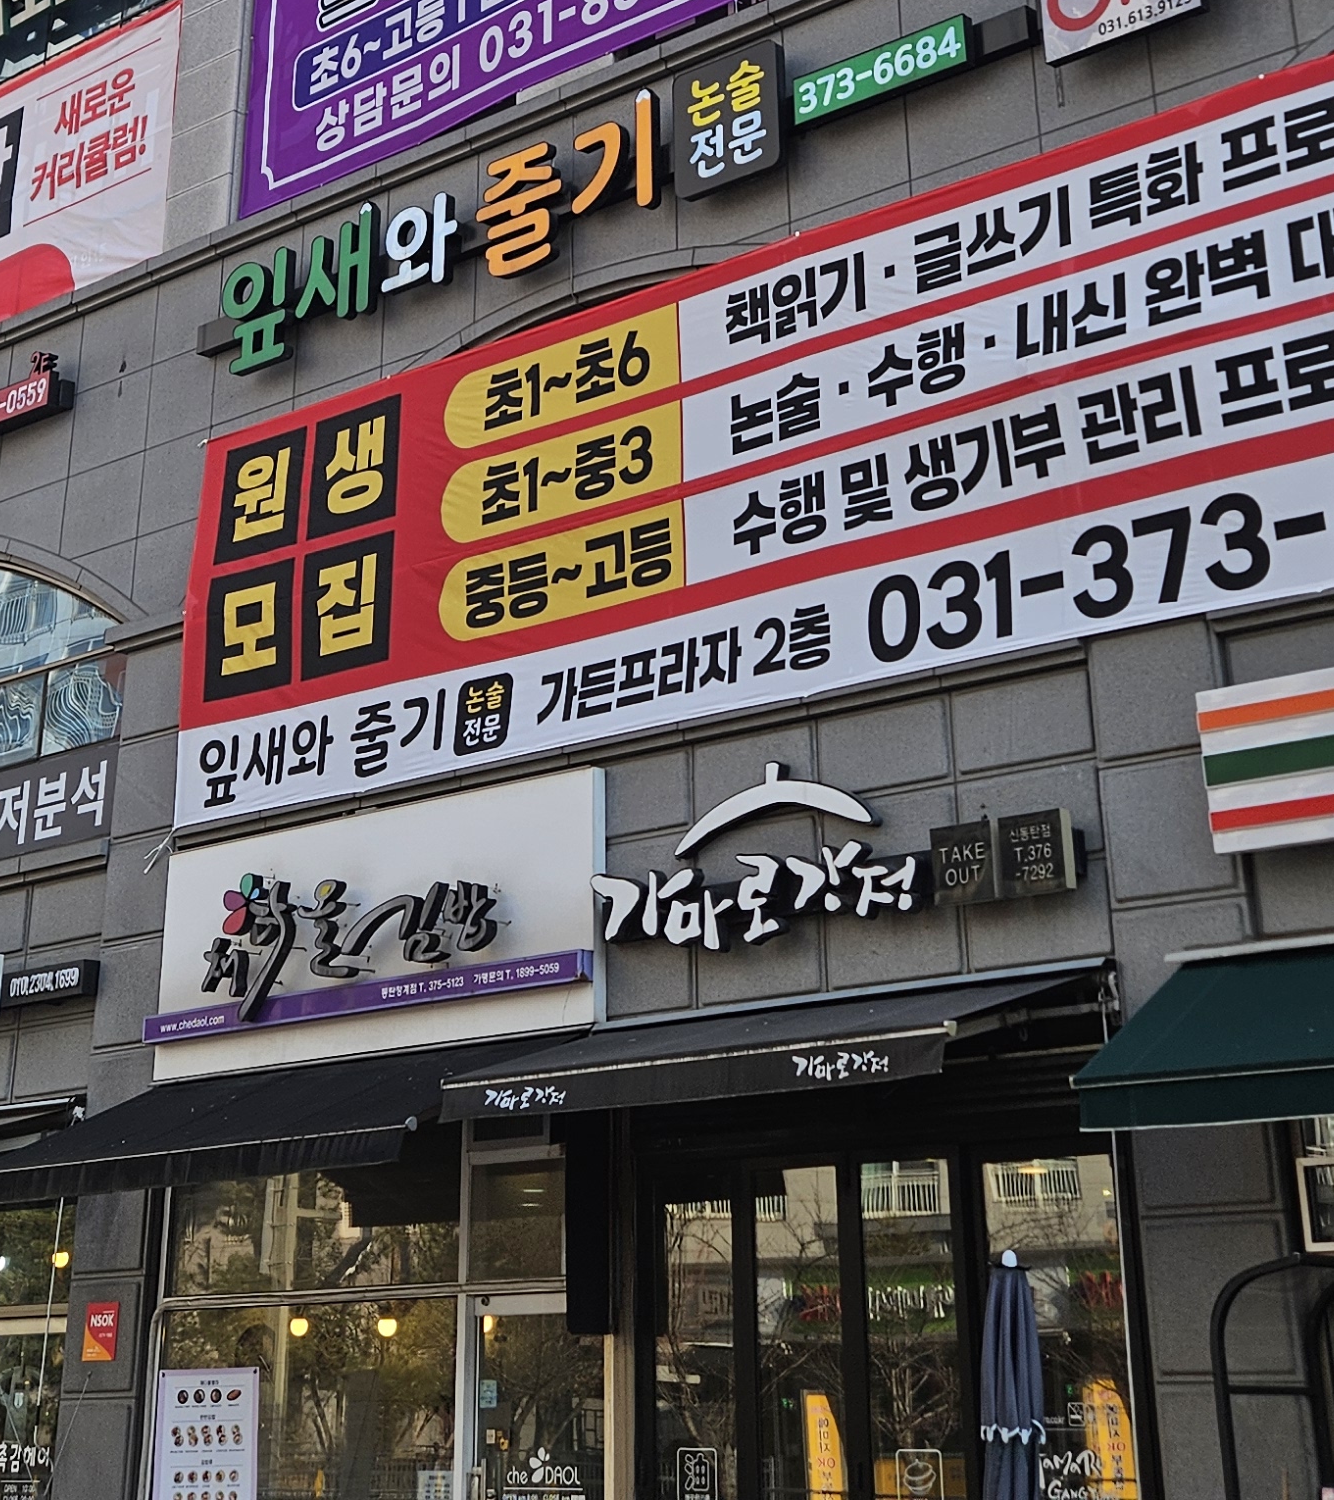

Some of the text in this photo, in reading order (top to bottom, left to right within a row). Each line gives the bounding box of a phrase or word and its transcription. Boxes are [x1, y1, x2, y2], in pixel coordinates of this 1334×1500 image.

[686, 60, 764, 130] 논술
[797, 25, 963, 114] 373-6684
[53, 66, 137, 138] 새로운
[314, 42, 462, 152] 상담문의
[28, 118, 148, 202] 커리큘럼!
[689, 108, 768, 179] 전문
[221, 86, 657, 375] 잎새와 줄기
[723, 253, 867, 347] 책읽기
[911, 186, 1073, 294] 글쓰기
[1087, 135, 1204, 233] 특화
[728, 370, 822, 456] 논술
[866, 316, 969, 410] 수행
[1013, 269, 1130, 362] 내신
[1144, 225, 1269, 318] 완벽
[731, 472, 827, 558] 수행
[839, 452, 894, 530] 및
[901, 398, 1068, 514] 생기부
[1076, 363, 1205, 465] 관리
[533, 624, 743, 727] 가든프라자
[752, 603, 833, 678] 2층
[463, 681, 505, 714] 논술
[198, 689, 445, 809] 잎새와 줄기
[460, 715, 503, 747] 전문
[938, 840, 987, 865] TAKE
[1008, 822, 1053, 843] 신동탄점
[1013, 841, 1053, 863] T.376
[589, 838, 918, 952] 가마로강정
[943, 863, 982, 888] OUT
[1013, 860, 1056, 882] -7292
[428, 961, 560, 993] 375-5123 가맹문의 1899-5059
[159, 1013, 226, 1035] www.chedaol.com
[790, 1049, 890, 1082] 가마로강정
[483, 1085, 567, 1111] 가마로강정
[88, 1311, 116, 1329] NSOK
[506, 1465, 582, 1486] che DAOL
